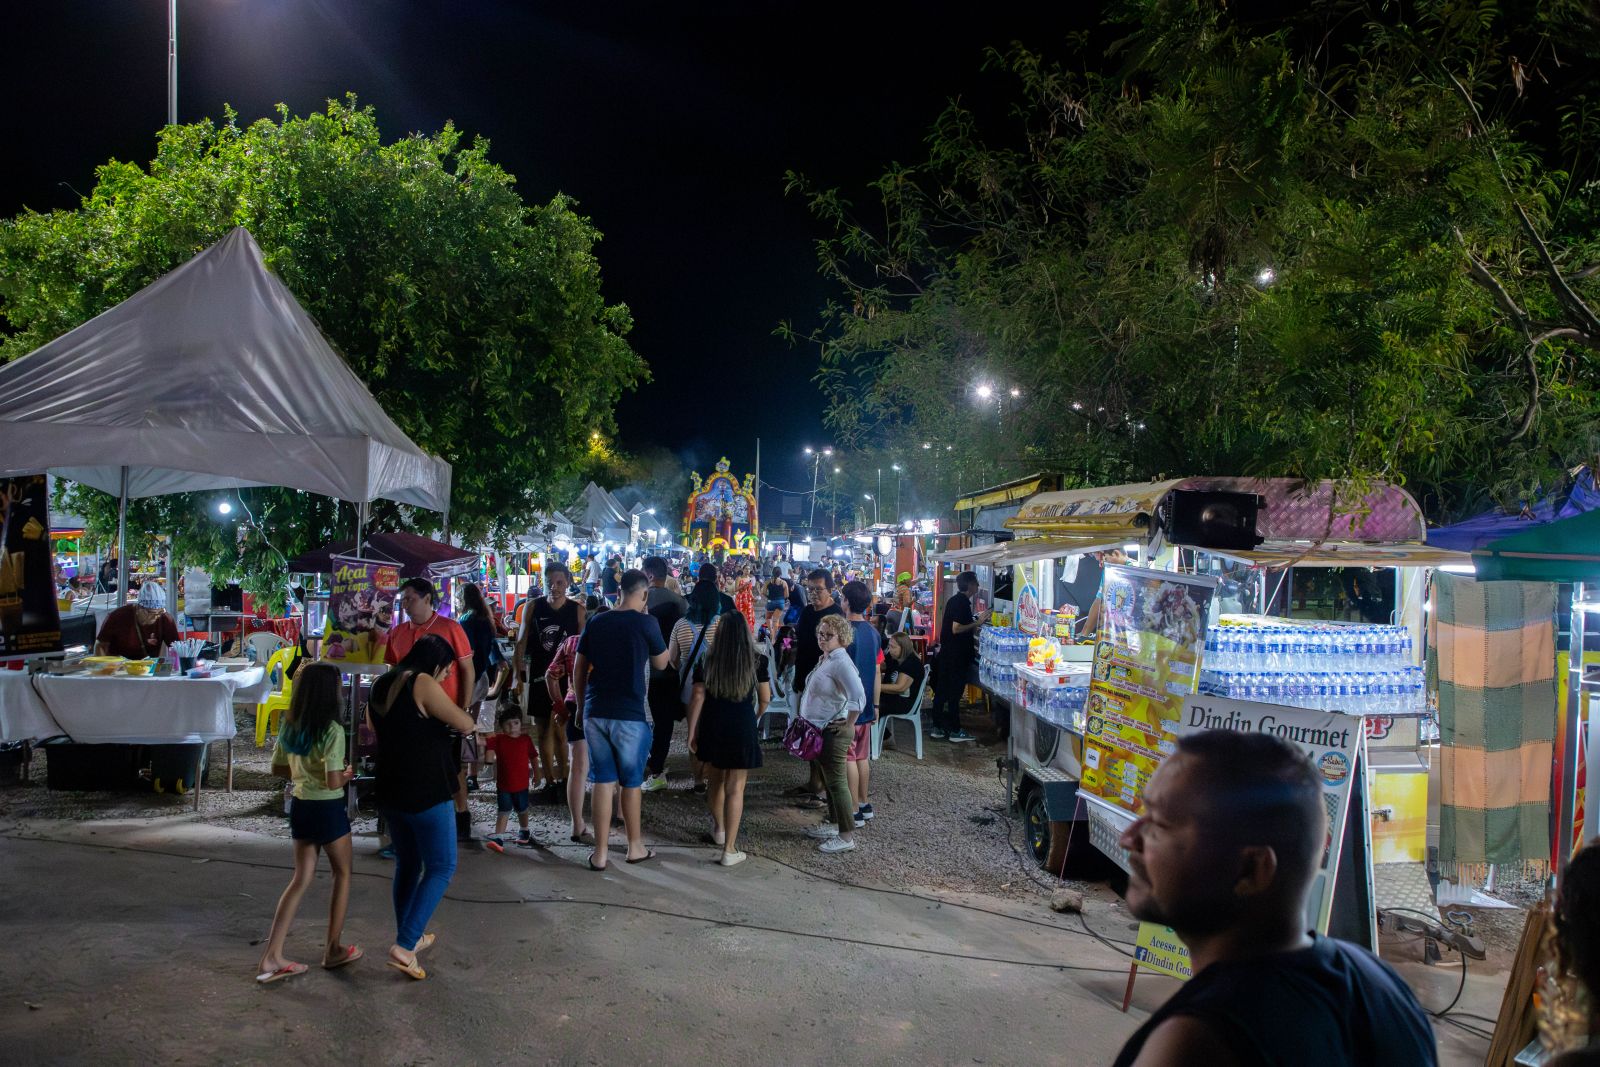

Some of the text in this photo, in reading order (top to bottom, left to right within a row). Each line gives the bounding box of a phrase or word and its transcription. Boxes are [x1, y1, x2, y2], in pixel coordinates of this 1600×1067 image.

[1188, 705, 1252, 733] Dindin
[1258, 715, 1349, 748] Gourmet
[1150, 935, 1190, 957] Acesse no
[1146, 951, 1174, 971] Dindin
